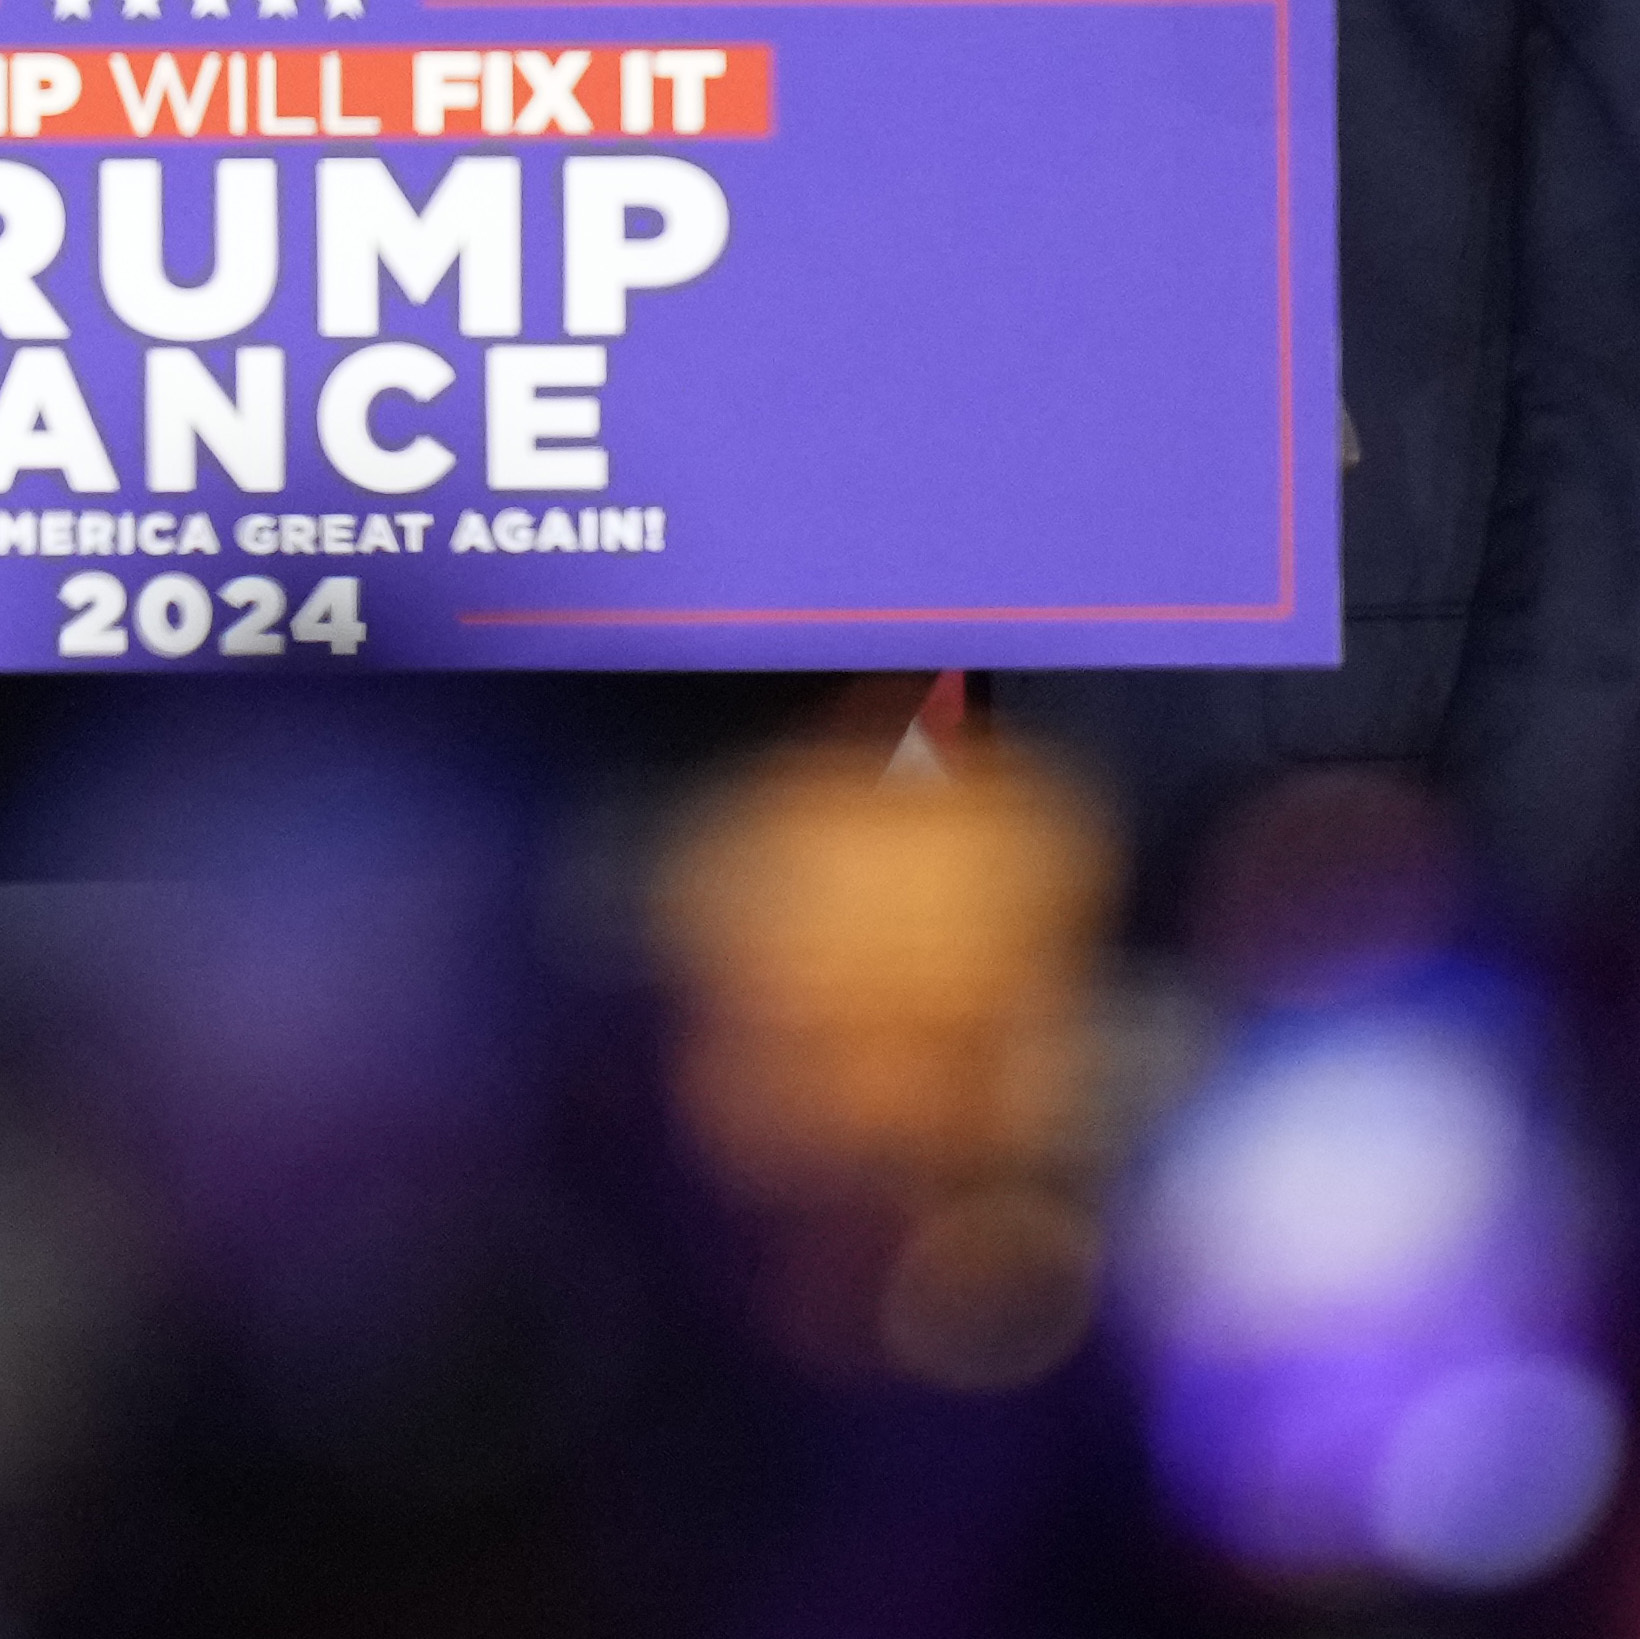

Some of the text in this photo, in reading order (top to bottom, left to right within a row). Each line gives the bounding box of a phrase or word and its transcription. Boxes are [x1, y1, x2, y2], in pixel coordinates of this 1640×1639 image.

[108, 51, 382, 138] WILL
[412, 50, 594, 136] FIX
[620, 49, 727, 135] IT
[236, 511, 435, 557] GREAT
[451, 506, 666, 554] AGAIN!
[57, 570, 366, 658] 2024
